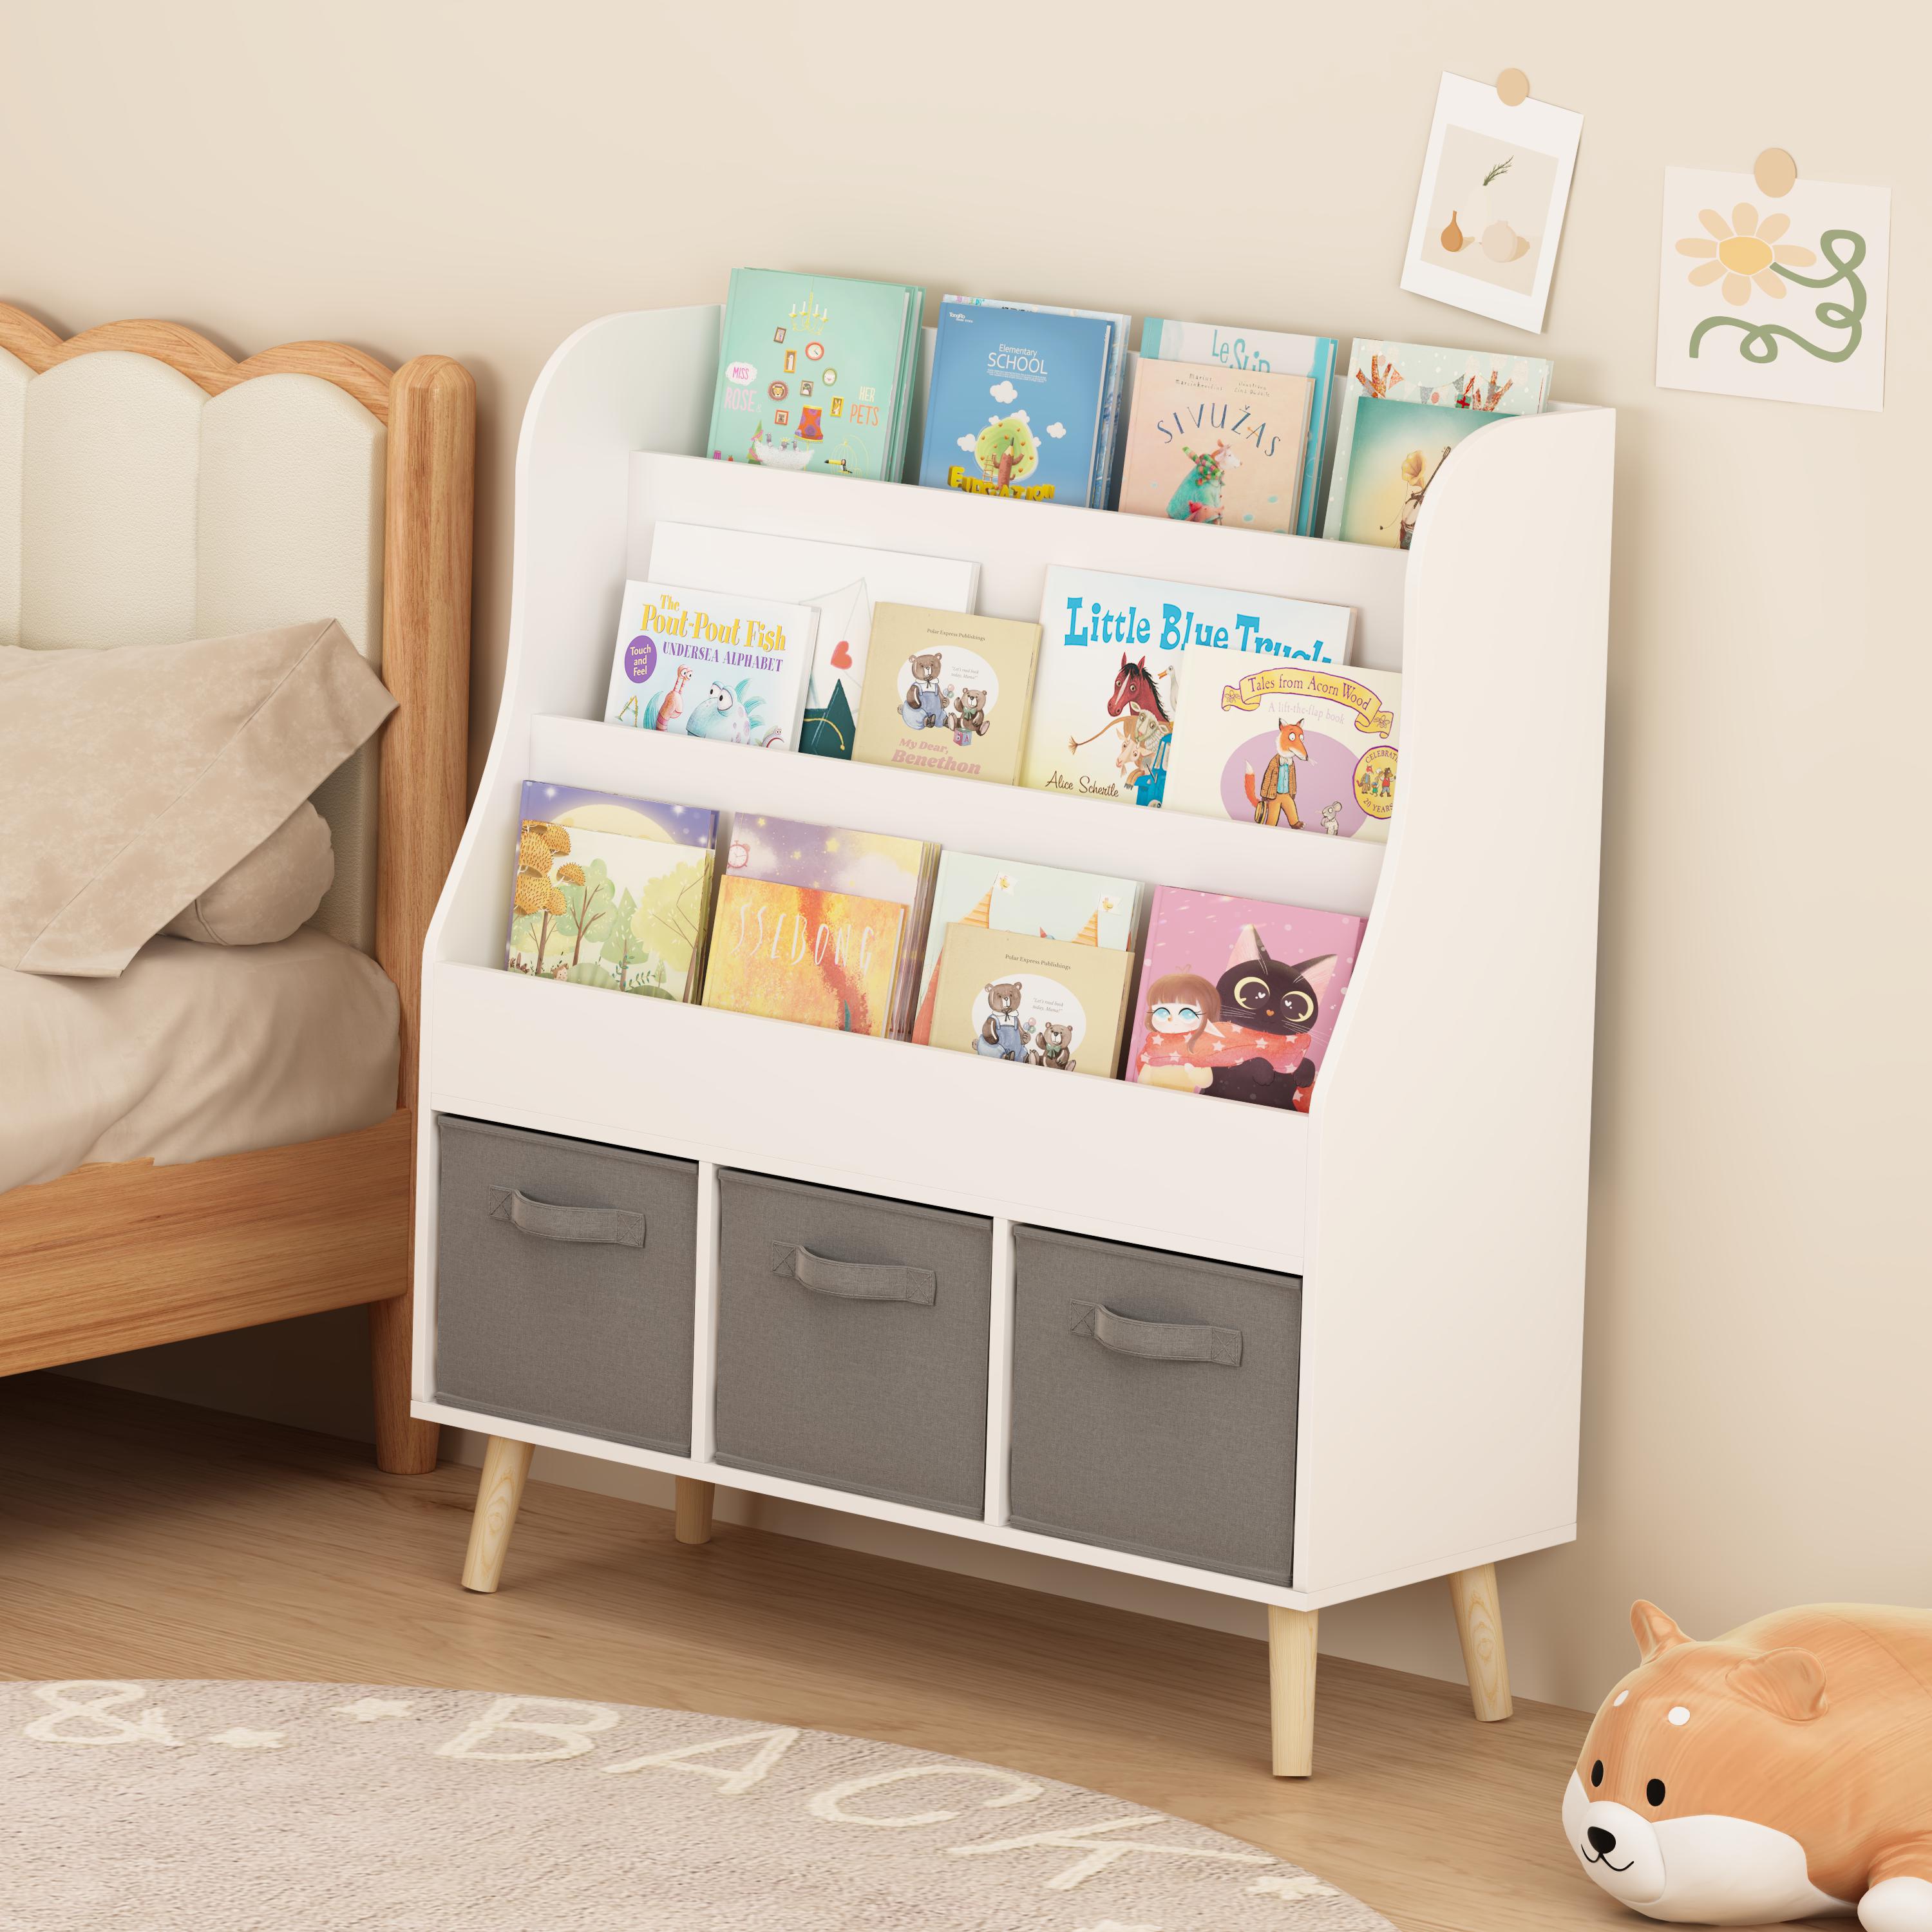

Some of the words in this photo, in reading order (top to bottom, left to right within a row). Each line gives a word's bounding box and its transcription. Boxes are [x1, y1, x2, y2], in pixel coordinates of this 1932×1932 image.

[999, 343, 1037, 359] Elementary
[1212, 329, 1229, 363] Le
[732, 366, 750, 380] MISS
[987, 352, 1048, 374] SCHOOL
[724, 386, 757, 412] ROSE
[859, 386, 876, 402] HER
[849, 404, 880, 426] PETS
[1157, 403, 1281, 457] SIVUŽAS
[660, 594, 680, 611] The
[639, 603, 741, 647] Pout-Pout
[743, 620, 786, 652] Fish
[1064, 596, 1150, 647] Little
[1159, 603, 1229, 651] Blue
[958, 632, 986, 641] Publishings
[630, 644, 651, 656] Touch
[663, 641, 719, 663] UNDERSEA
[722, 650, 784, 672] ALPHABET
[633, 666, 648, 677] Feel
[634, 656, 647, 667] and
[1248, 676, 1275, 692] Tales
[1278, 674, 1303, 689] from
[1307, 676, 1339, 696] Acorn
[1343, 682, 1372, 711] Wood
[1268, 703, 1275, 713] A
[1278, 702, 1323, 721] lift-the-flap
[1325, 710, 1345, 724] book
[899, 738, 918, 750] My
[919, 741, 949, 754] Dear,
[1365, 750, 1398, 763] CELEBRATI
[891, 749, 981, 775] Benethon
[1045, 770, 1074, 790] Alice
[1079, 775, 1119, 797] Schertle
[1363, 798, 1372, 808] 20
[1372, 802, 1393, 813] YEARS
[1041, 960, 1071, 971] Publishings
[24, 1680, 184, 1747] &
[433, 1696, 1279, 1890] BACK
